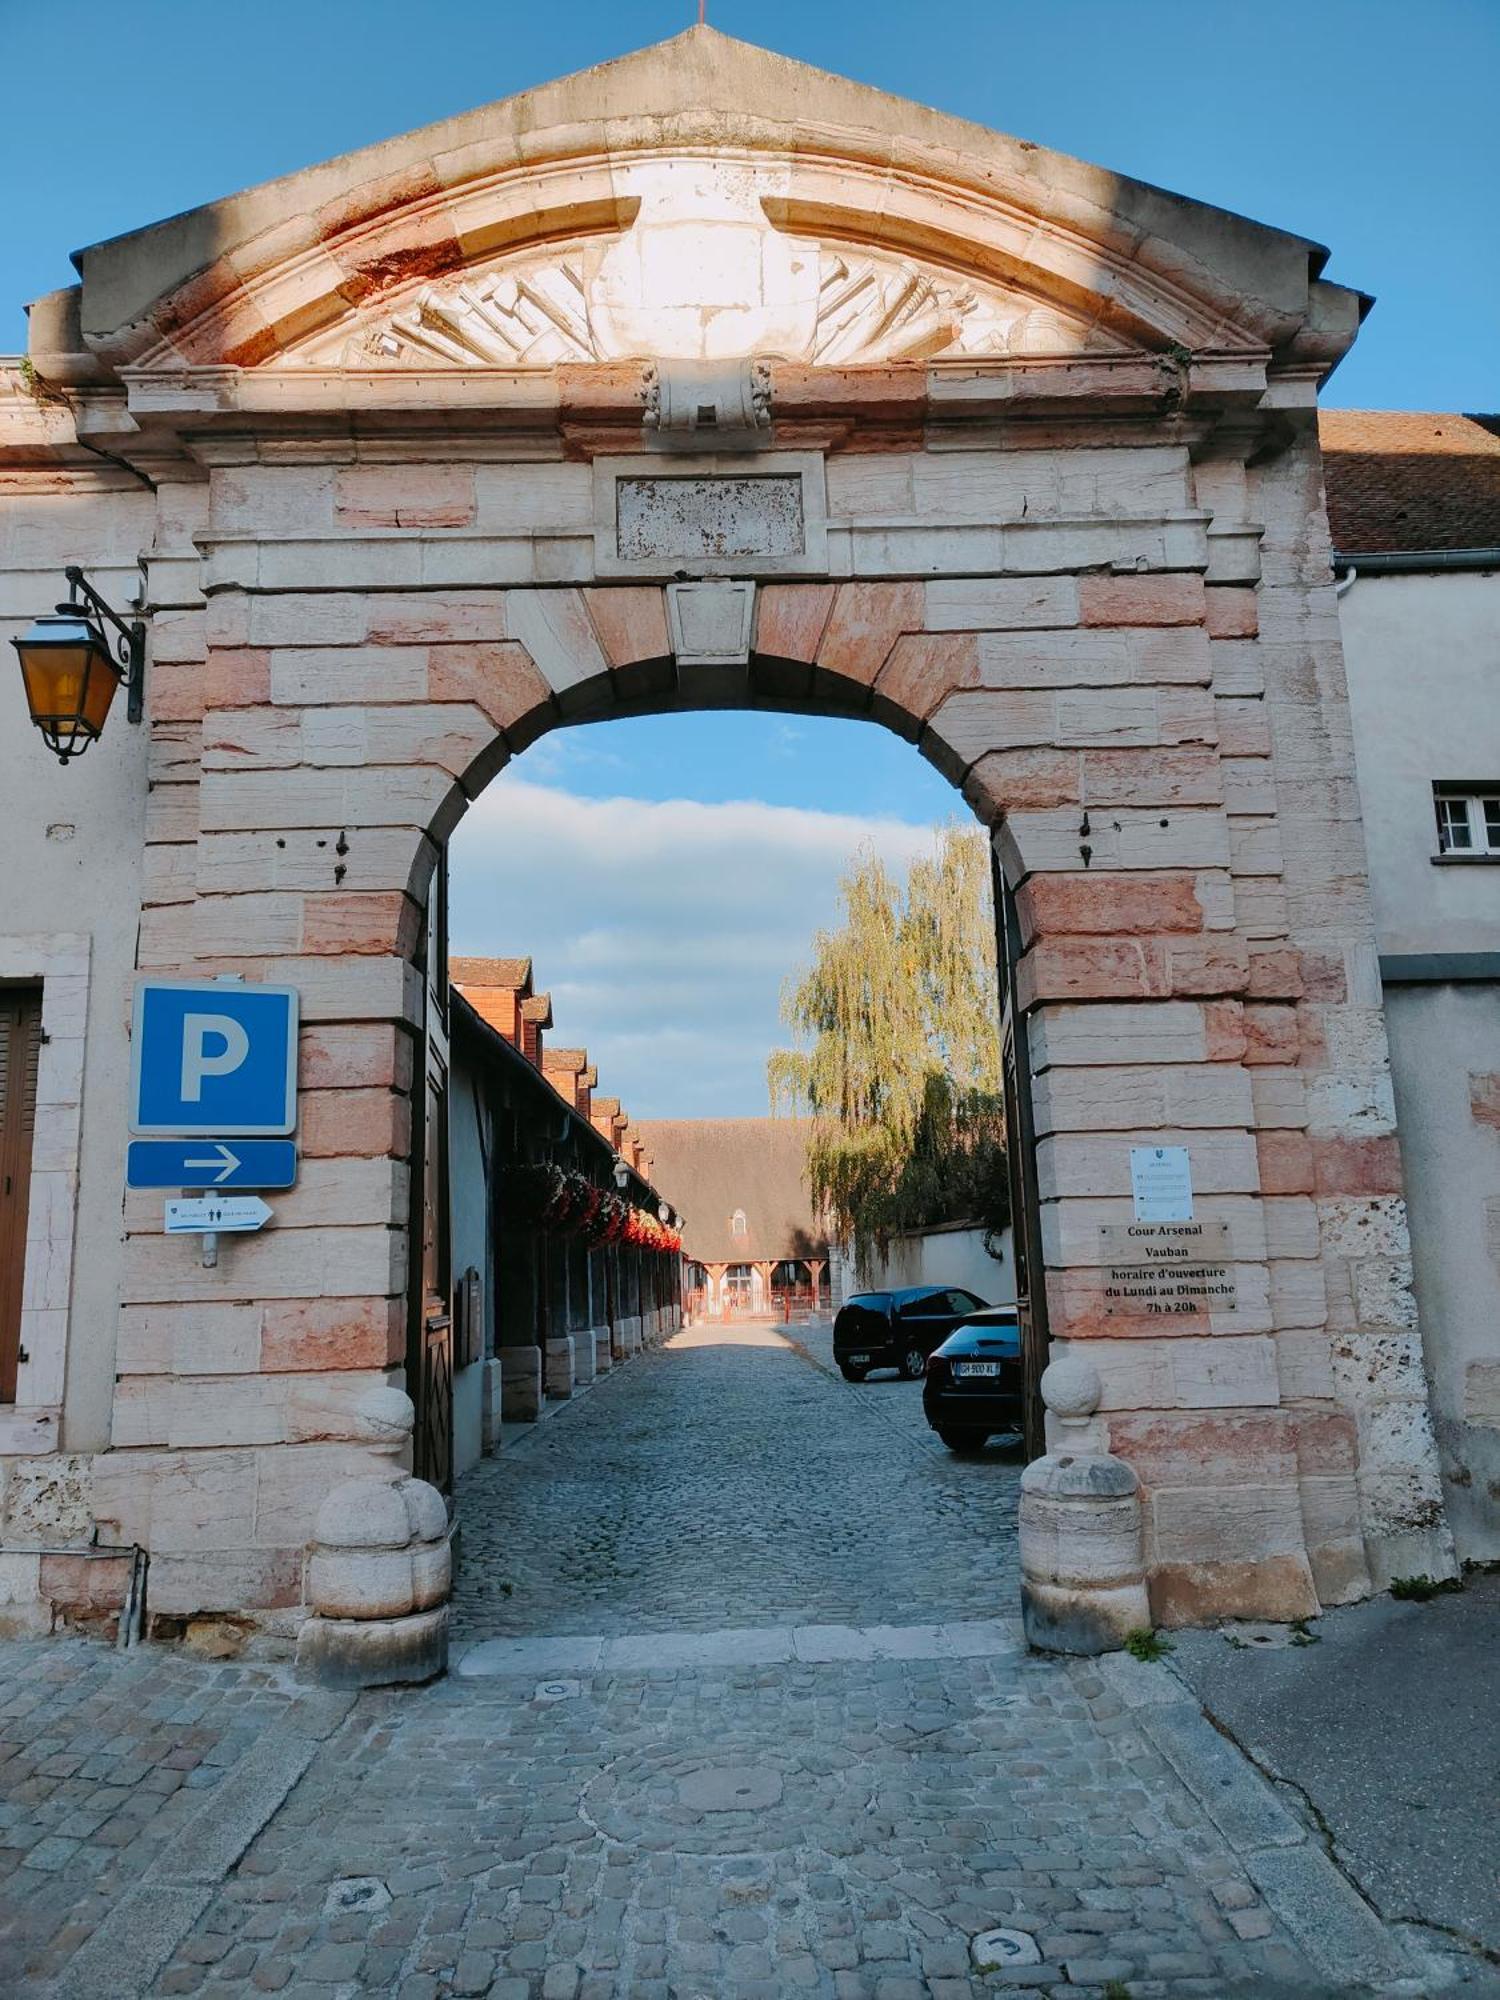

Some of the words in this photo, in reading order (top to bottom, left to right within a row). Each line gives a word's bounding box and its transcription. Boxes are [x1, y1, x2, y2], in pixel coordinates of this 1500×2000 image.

[181, 1013, 250, 1102] P
[1128, 1226, 1155, 1236] Cour
[1158, 1225, 1202, 1236] Arsenal
[1145, 1247, 1188, 1257] Vauban
[1112, 1269, 1154, 1279] horaire
[1158, 1268, 1226, 1279] d'ouverture
[1106, 1287, 1121, 1297] du
[1124, 1286, 1157, 1297] Lundi
[1160, 1288, 1174, 1296] au
[1177, 1284, 1235, 1296] Dimanche
[1147, 1303, 1161, 1313] 7h
[1164, 1302, 1171, 1312] à
[1175, 1302, 1196, 1312] 20h
